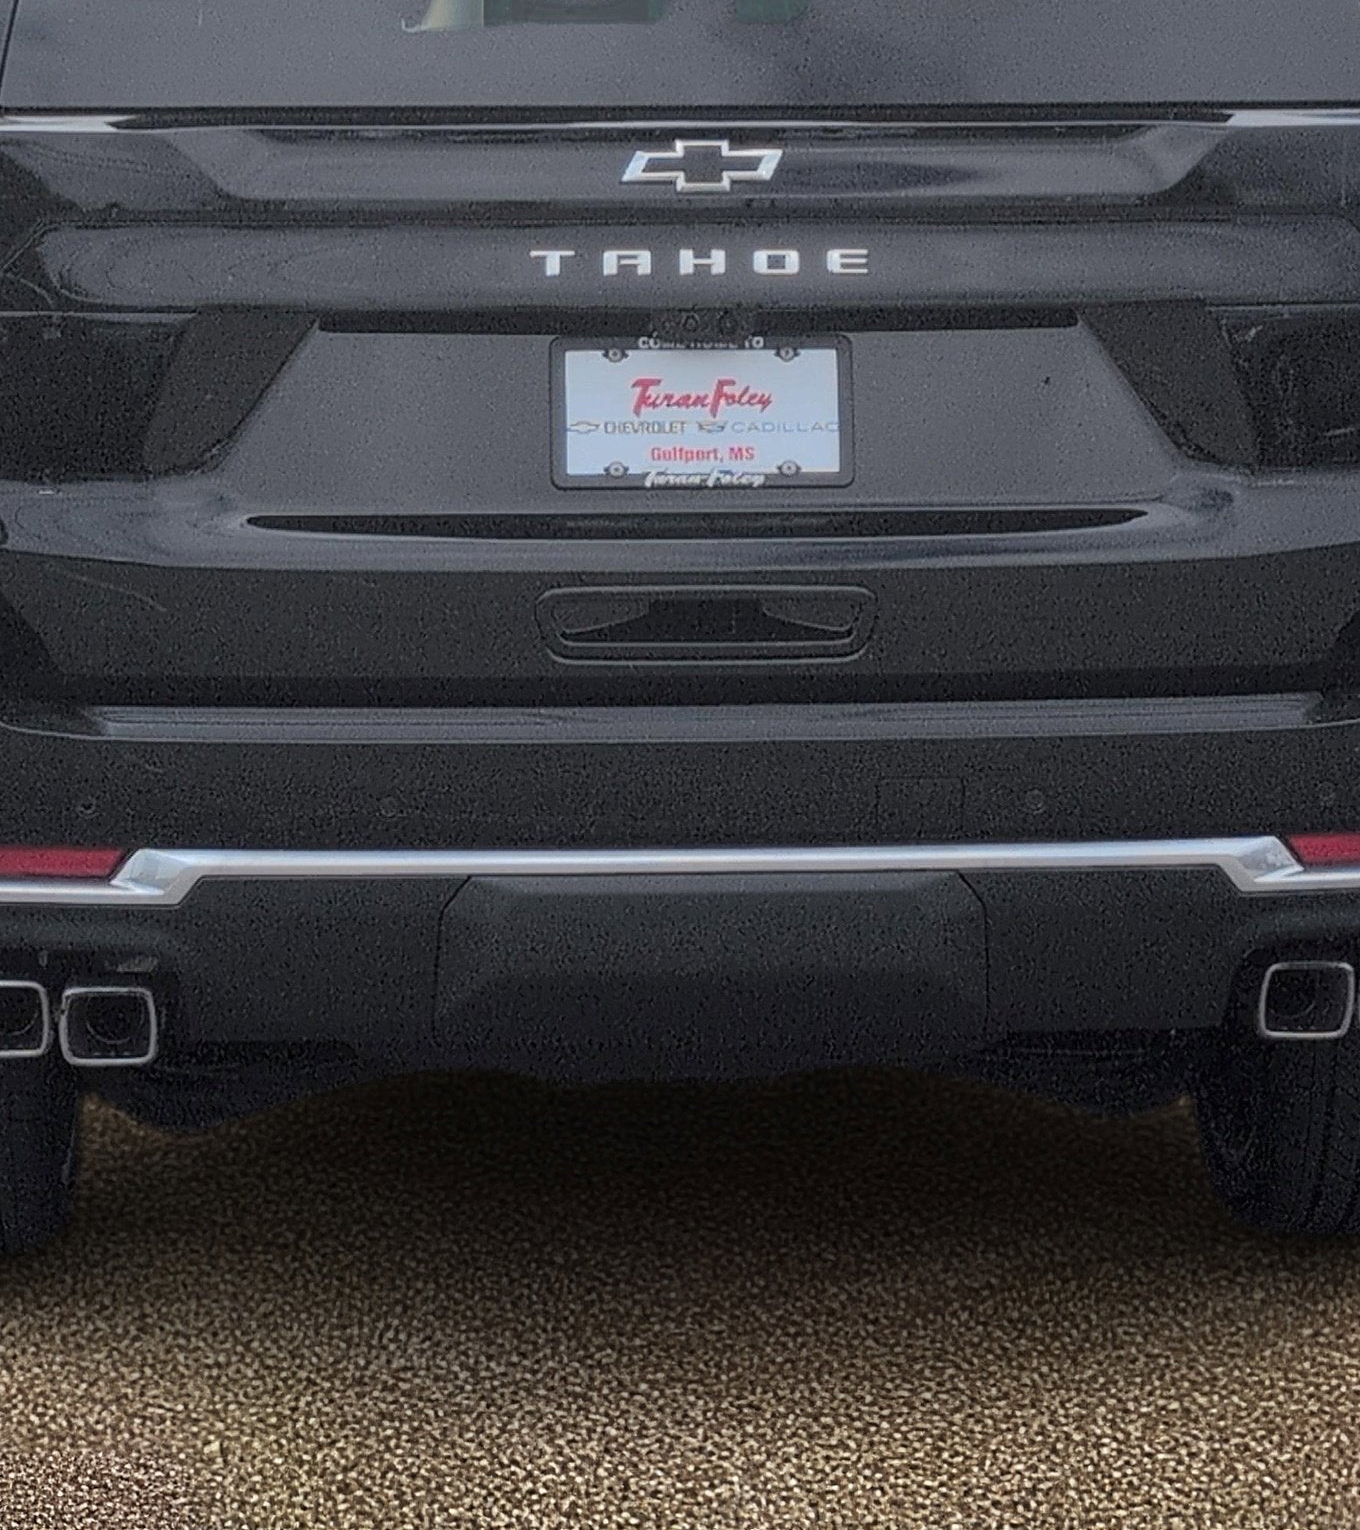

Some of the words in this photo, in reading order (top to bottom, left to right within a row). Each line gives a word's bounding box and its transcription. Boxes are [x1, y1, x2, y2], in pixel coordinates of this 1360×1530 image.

[530, 248, 869, 277] TAHOE
[604, 421, 686, 435] CHEVROLET
[650, 446, 724, 463] Gulfport,
[729, 446, 756, 461] MS
